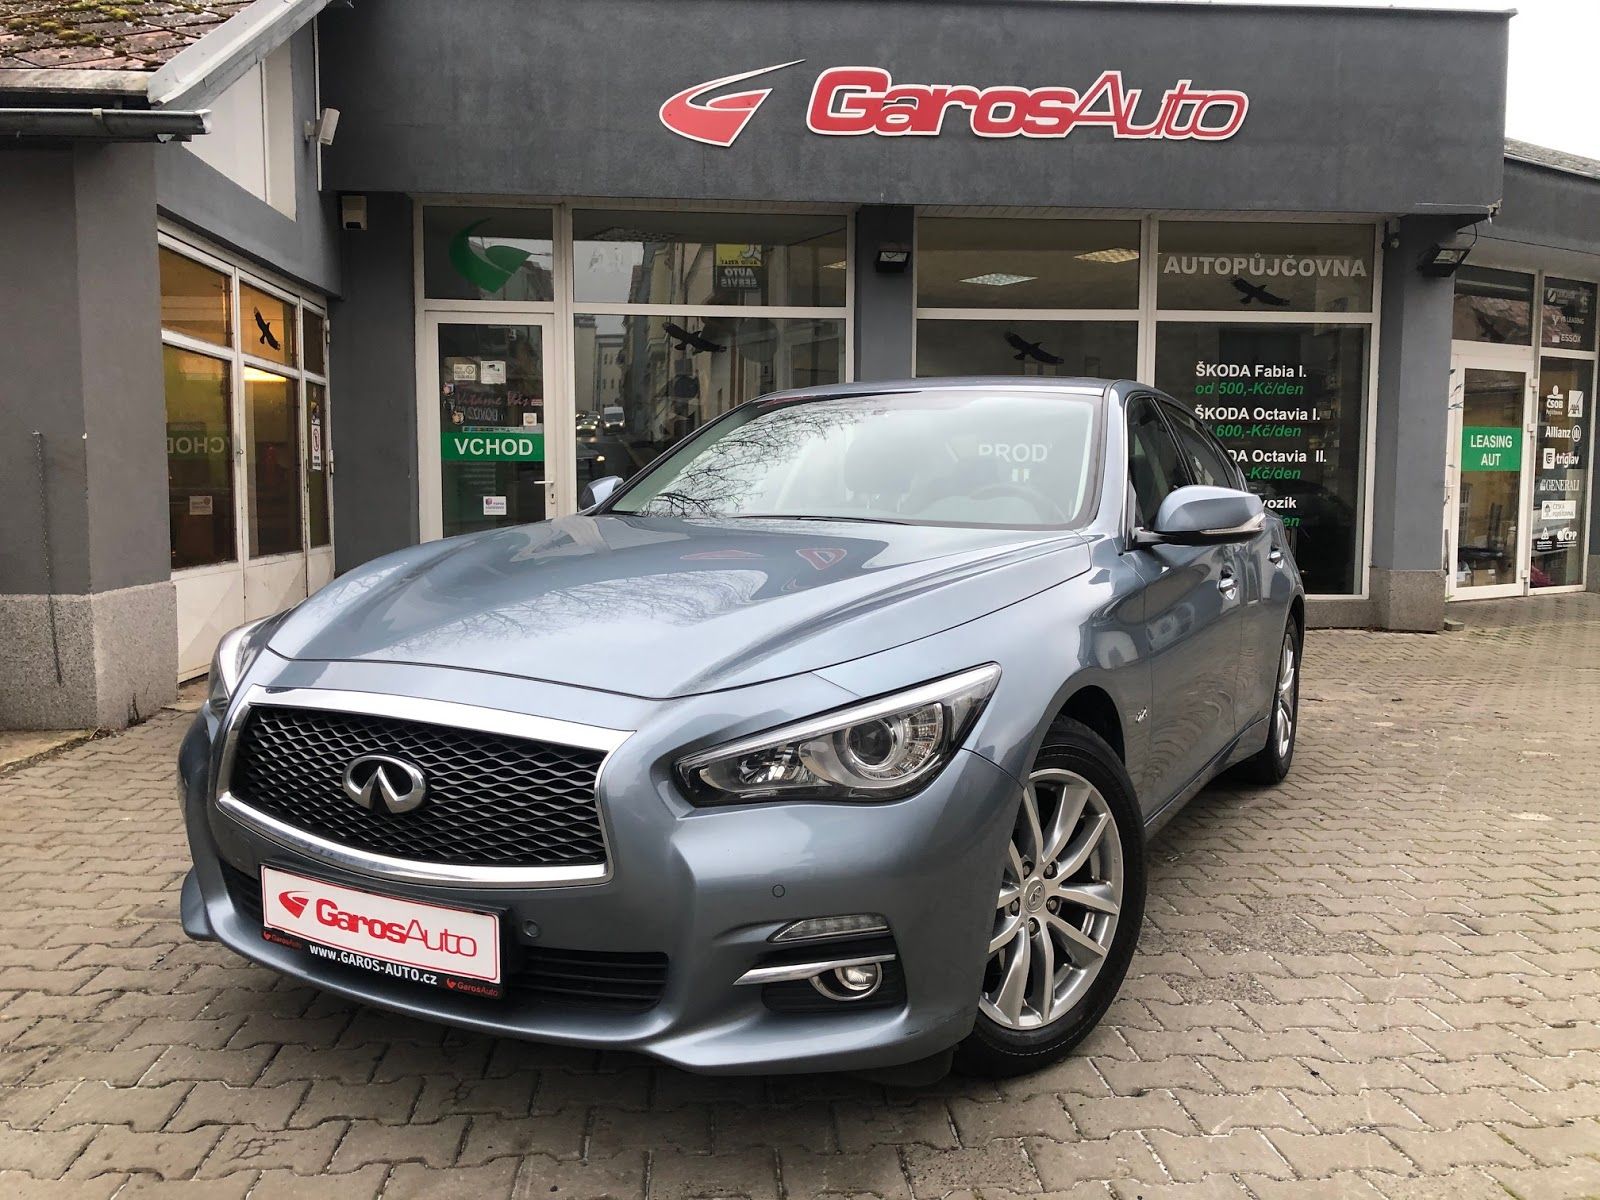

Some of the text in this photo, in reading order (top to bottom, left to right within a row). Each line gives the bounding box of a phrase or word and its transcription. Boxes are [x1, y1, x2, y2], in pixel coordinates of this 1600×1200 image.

[807, 65, 1251, 142] GarosAuto
[1163, 252, 1367, 278] AUTOPŮJČOVNA
[1195, 361, 1251, 378] ŠKODA
[1254, 364, 1295, 378] Fabia
[1195, 382, 1214, 395] od
[1194, 404, 1250, 420] ŠKODA
[1253, 407, 1308, 421] Octavia
[1545, 425, 1571, 439] Allianz
[454, 438, 534, 456] VCHOD
[1470, 434, 1513, 448] LEASING
[1252, 449, 1307, 463] Octavia
[1480, 453, 1502, 466] AUT
[1556, 450, 1580, 468] triglav
[1245, 466, 1302, 480] -Kč/den
[1545, 479, 1580, 491] GENERALI
[315, 897, 478, 958] GarosAuto
[309, 943, 438, 986] www.GAROS-AUTO.cz
[457, 981, 499, 997] GarosAuto
